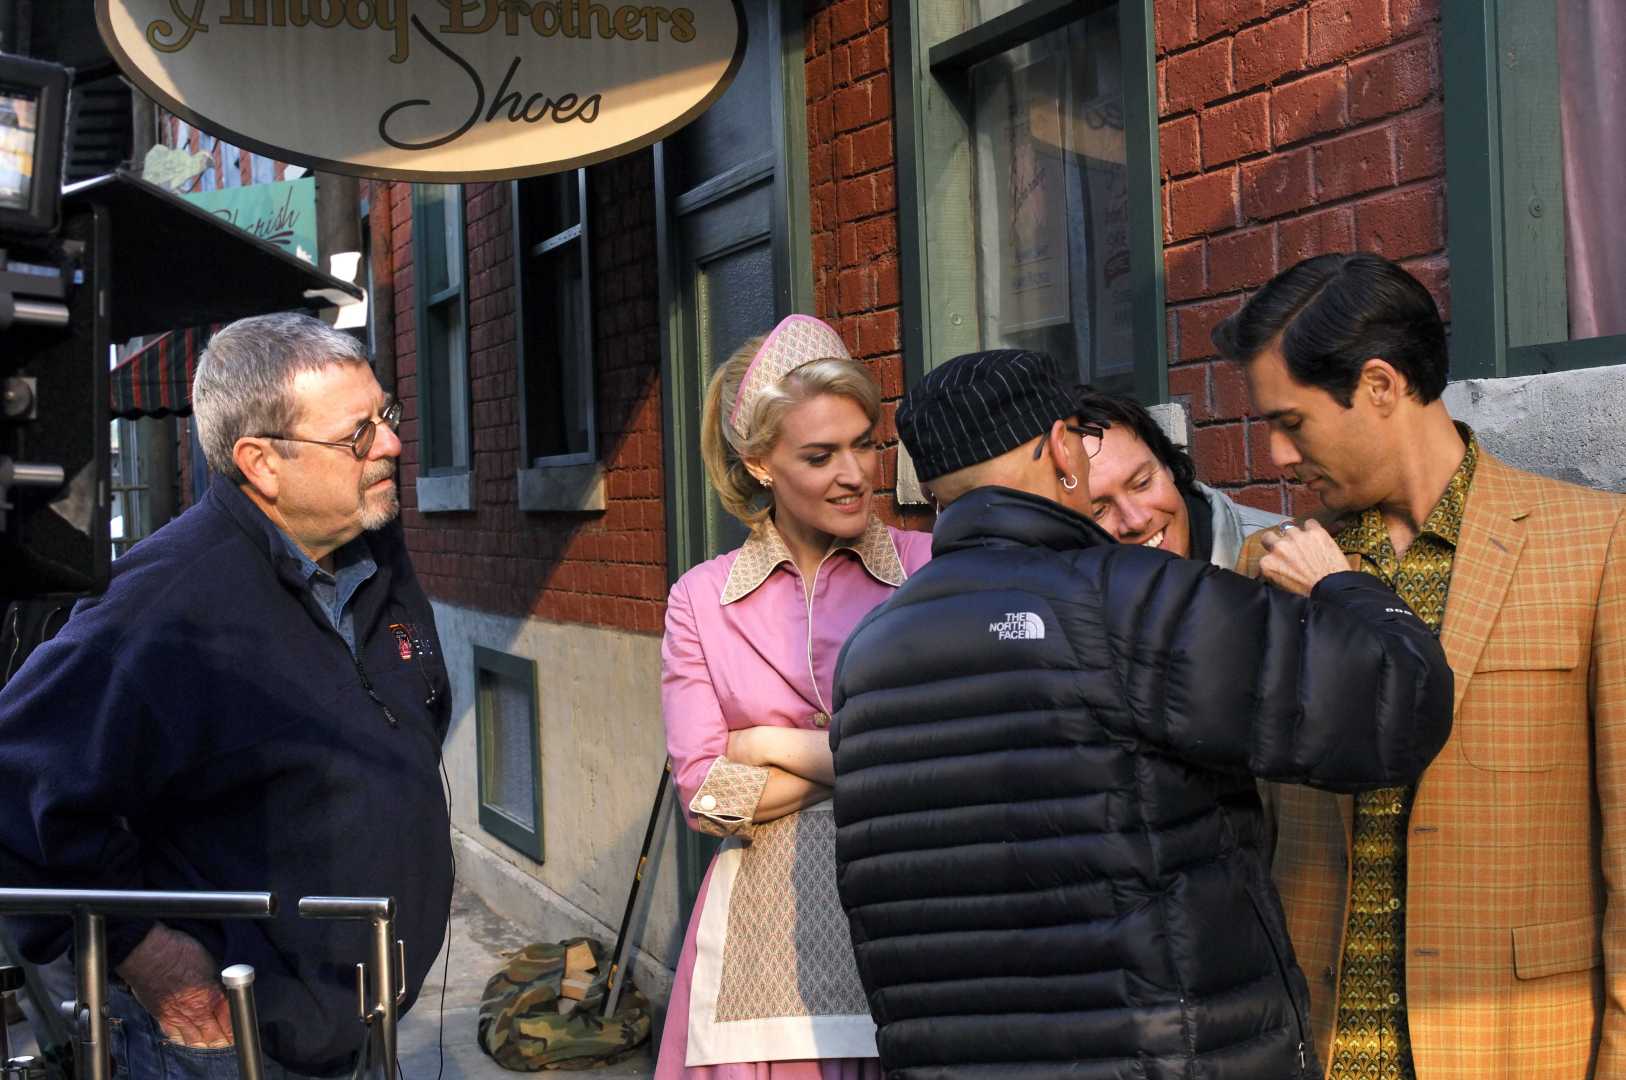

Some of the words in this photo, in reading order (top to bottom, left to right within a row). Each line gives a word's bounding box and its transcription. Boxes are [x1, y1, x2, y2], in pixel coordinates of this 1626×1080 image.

[378, 13, 602, 150] Shoes
[1004, 612, 1026, 623] THE
[989, 621, 1026, 632] NORTH
[998, 630, 1026, 640] FACE
